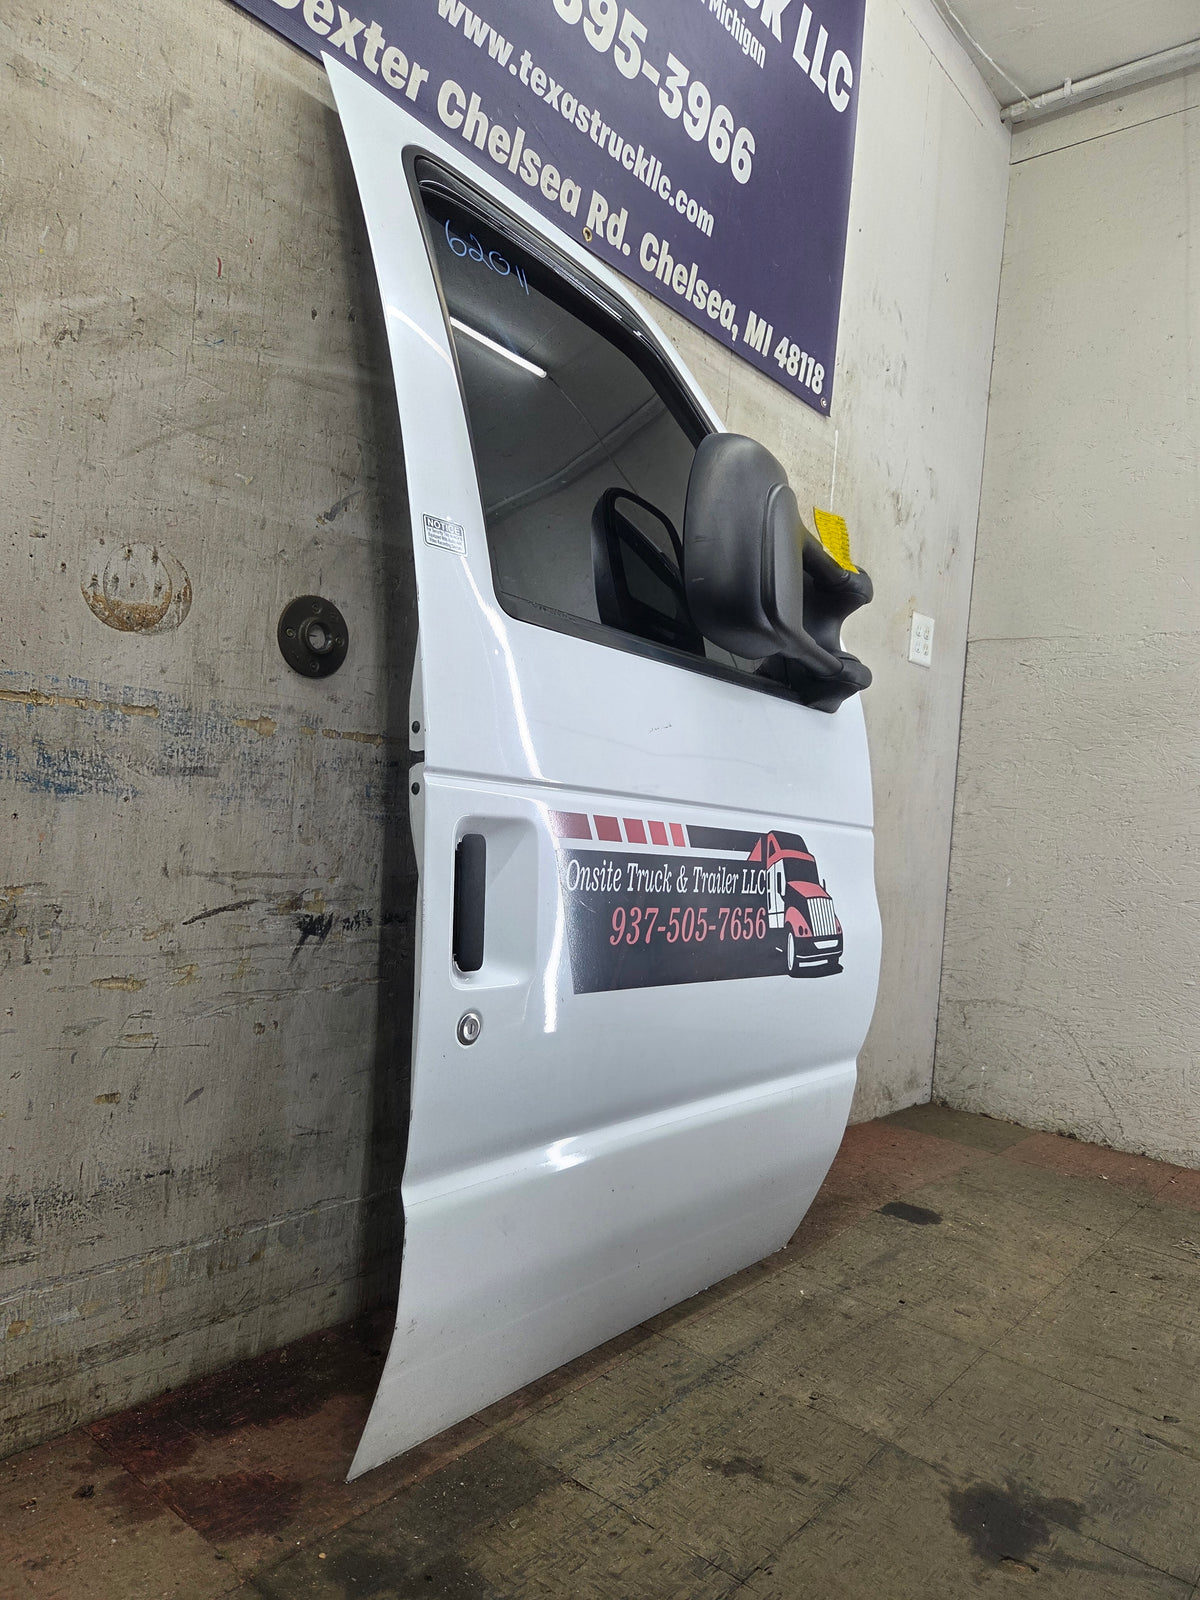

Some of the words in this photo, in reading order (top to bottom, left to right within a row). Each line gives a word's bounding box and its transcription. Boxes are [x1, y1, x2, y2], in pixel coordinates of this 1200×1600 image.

[708, 0, 767, 69] Michigan
[792, 3, 853, 113] LLC
[437, 0, 715, 238] www.texastruckllc.com
[271, 0, 430, 102] exter
[437, 79, 582, 218] Chelsea
[586, 189, 631, 256] Rd.
[639, 231, 739, 342] Chelsea,
[743, 310, 774, 357] MI
[773, 336, 826, 395] 48118
[425, 516, 463, 537] NOTICE
[566, 859, 622, 892] Onsite
[627, 862, 673, 893] Truck
[676, 865, 689, 893] &
[692, 865, 739, 894] Trailer
[741, 868, 767, 895] LLC
[609, 906, 767, 946] 937-505-7656
